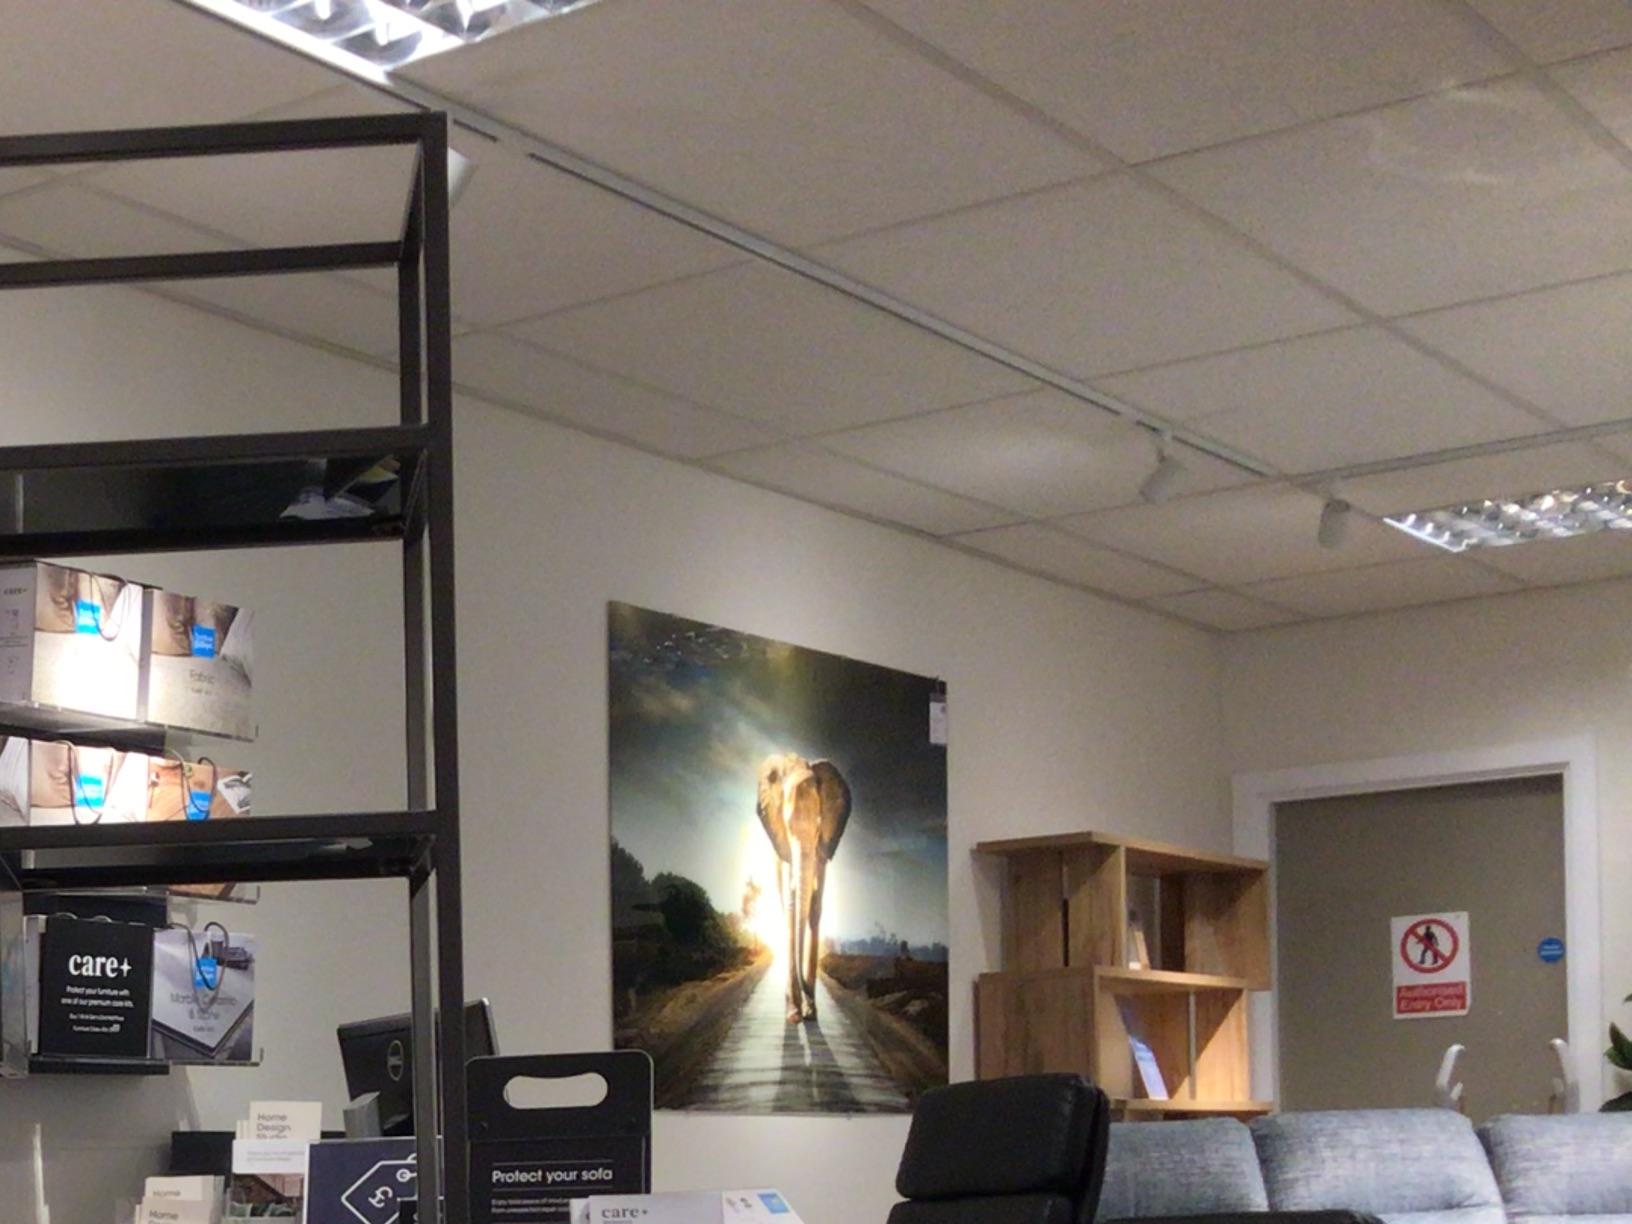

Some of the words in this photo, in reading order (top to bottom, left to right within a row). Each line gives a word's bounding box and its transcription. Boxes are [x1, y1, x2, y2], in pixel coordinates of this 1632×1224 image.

[68, 953, 133, 978] care+
[1399, 998, 1431, 1011] Entry
[1434, 996, 1462, 1010] Only
[257, 1113, 287, 1122] Home
[256, 1123, 291, 1133] Design
[491, 1170, 542, 1183] Protect
[546, 1170, 578, 1184] your
[581, 1167, 613, 1181] sofa
[149, 1209, 179, 1220] Home
